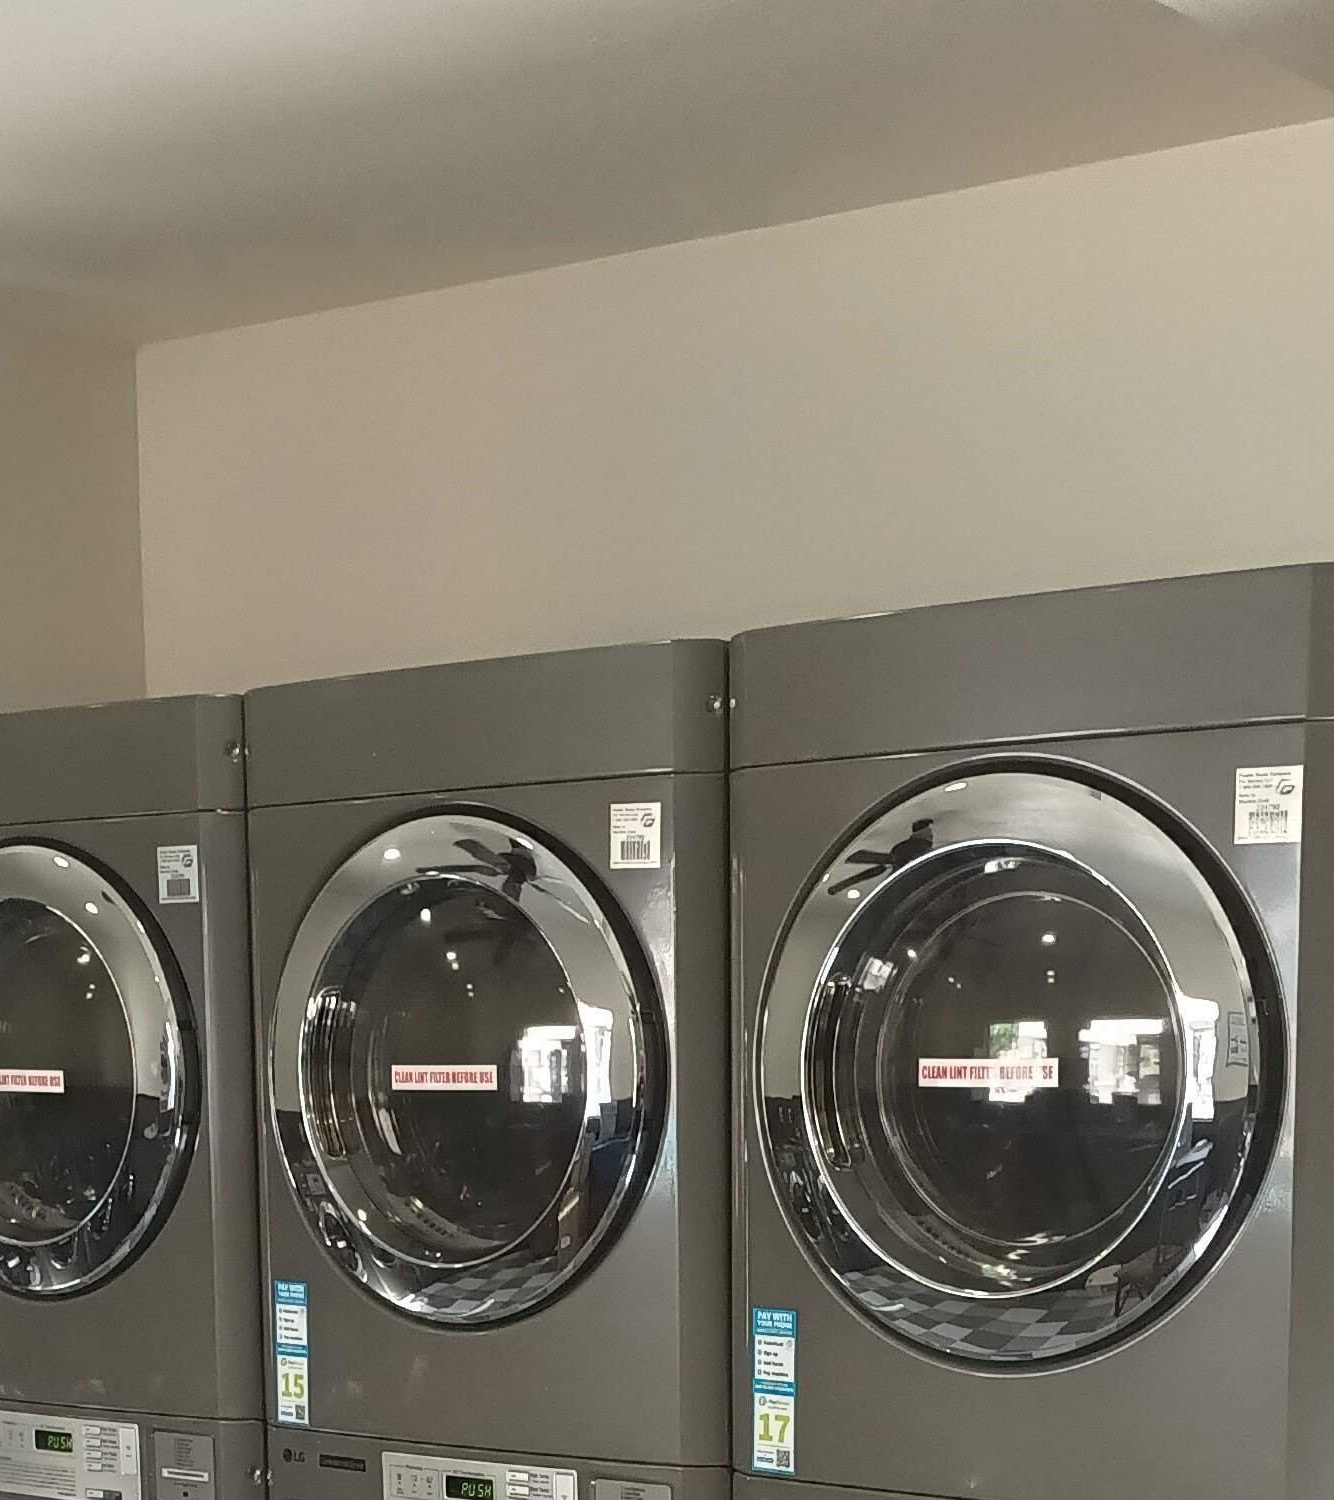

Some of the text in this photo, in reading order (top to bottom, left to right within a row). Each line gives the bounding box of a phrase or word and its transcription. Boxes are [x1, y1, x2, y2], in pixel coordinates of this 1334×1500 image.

[395, 1071, 492, 1083] CLEAN LINT FILTER BEFORE USE
[922, 1066, 947, 1079] CLEAN
[950, 1066, 967, 1079] LINT
[1037, 1066, 1053, 1079] SE
[758, 1311, 792, 1322] PAY WITH
[282, 1373, 304, 1399] 15
[759, 1413, 790, 1443] 17
[461, 1482, 491, 1497] PUSH
